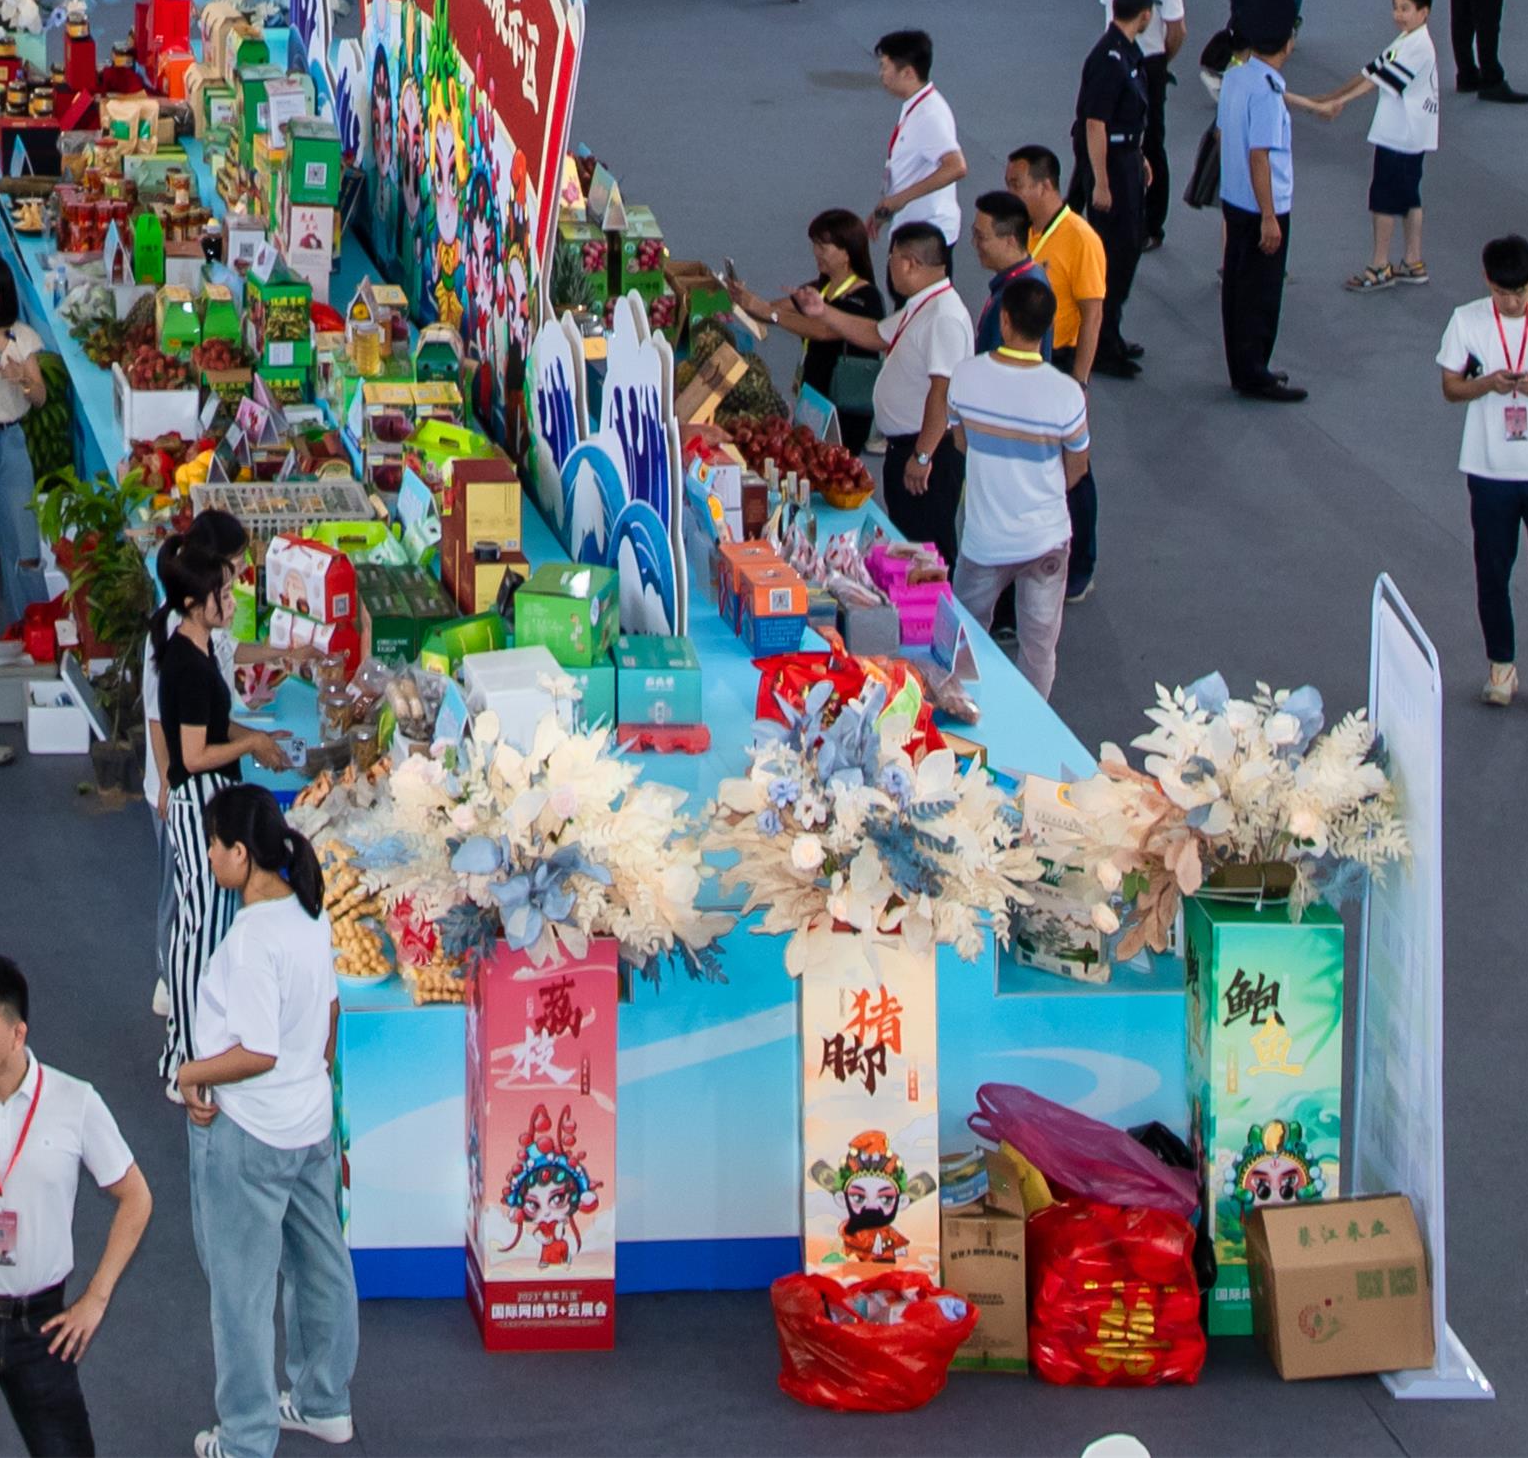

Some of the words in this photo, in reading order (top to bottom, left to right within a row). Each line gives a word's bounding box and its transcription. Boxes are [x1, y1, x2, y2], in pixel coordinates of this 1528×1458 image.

[510, 975, 583, 1085] 荔枝
[819, 982, 903, 1098] 猪脚
[1223, 967, 1303, 1077] 鲍鱼
[491, 1302, 608, 1319] 国际网络节+云展会
